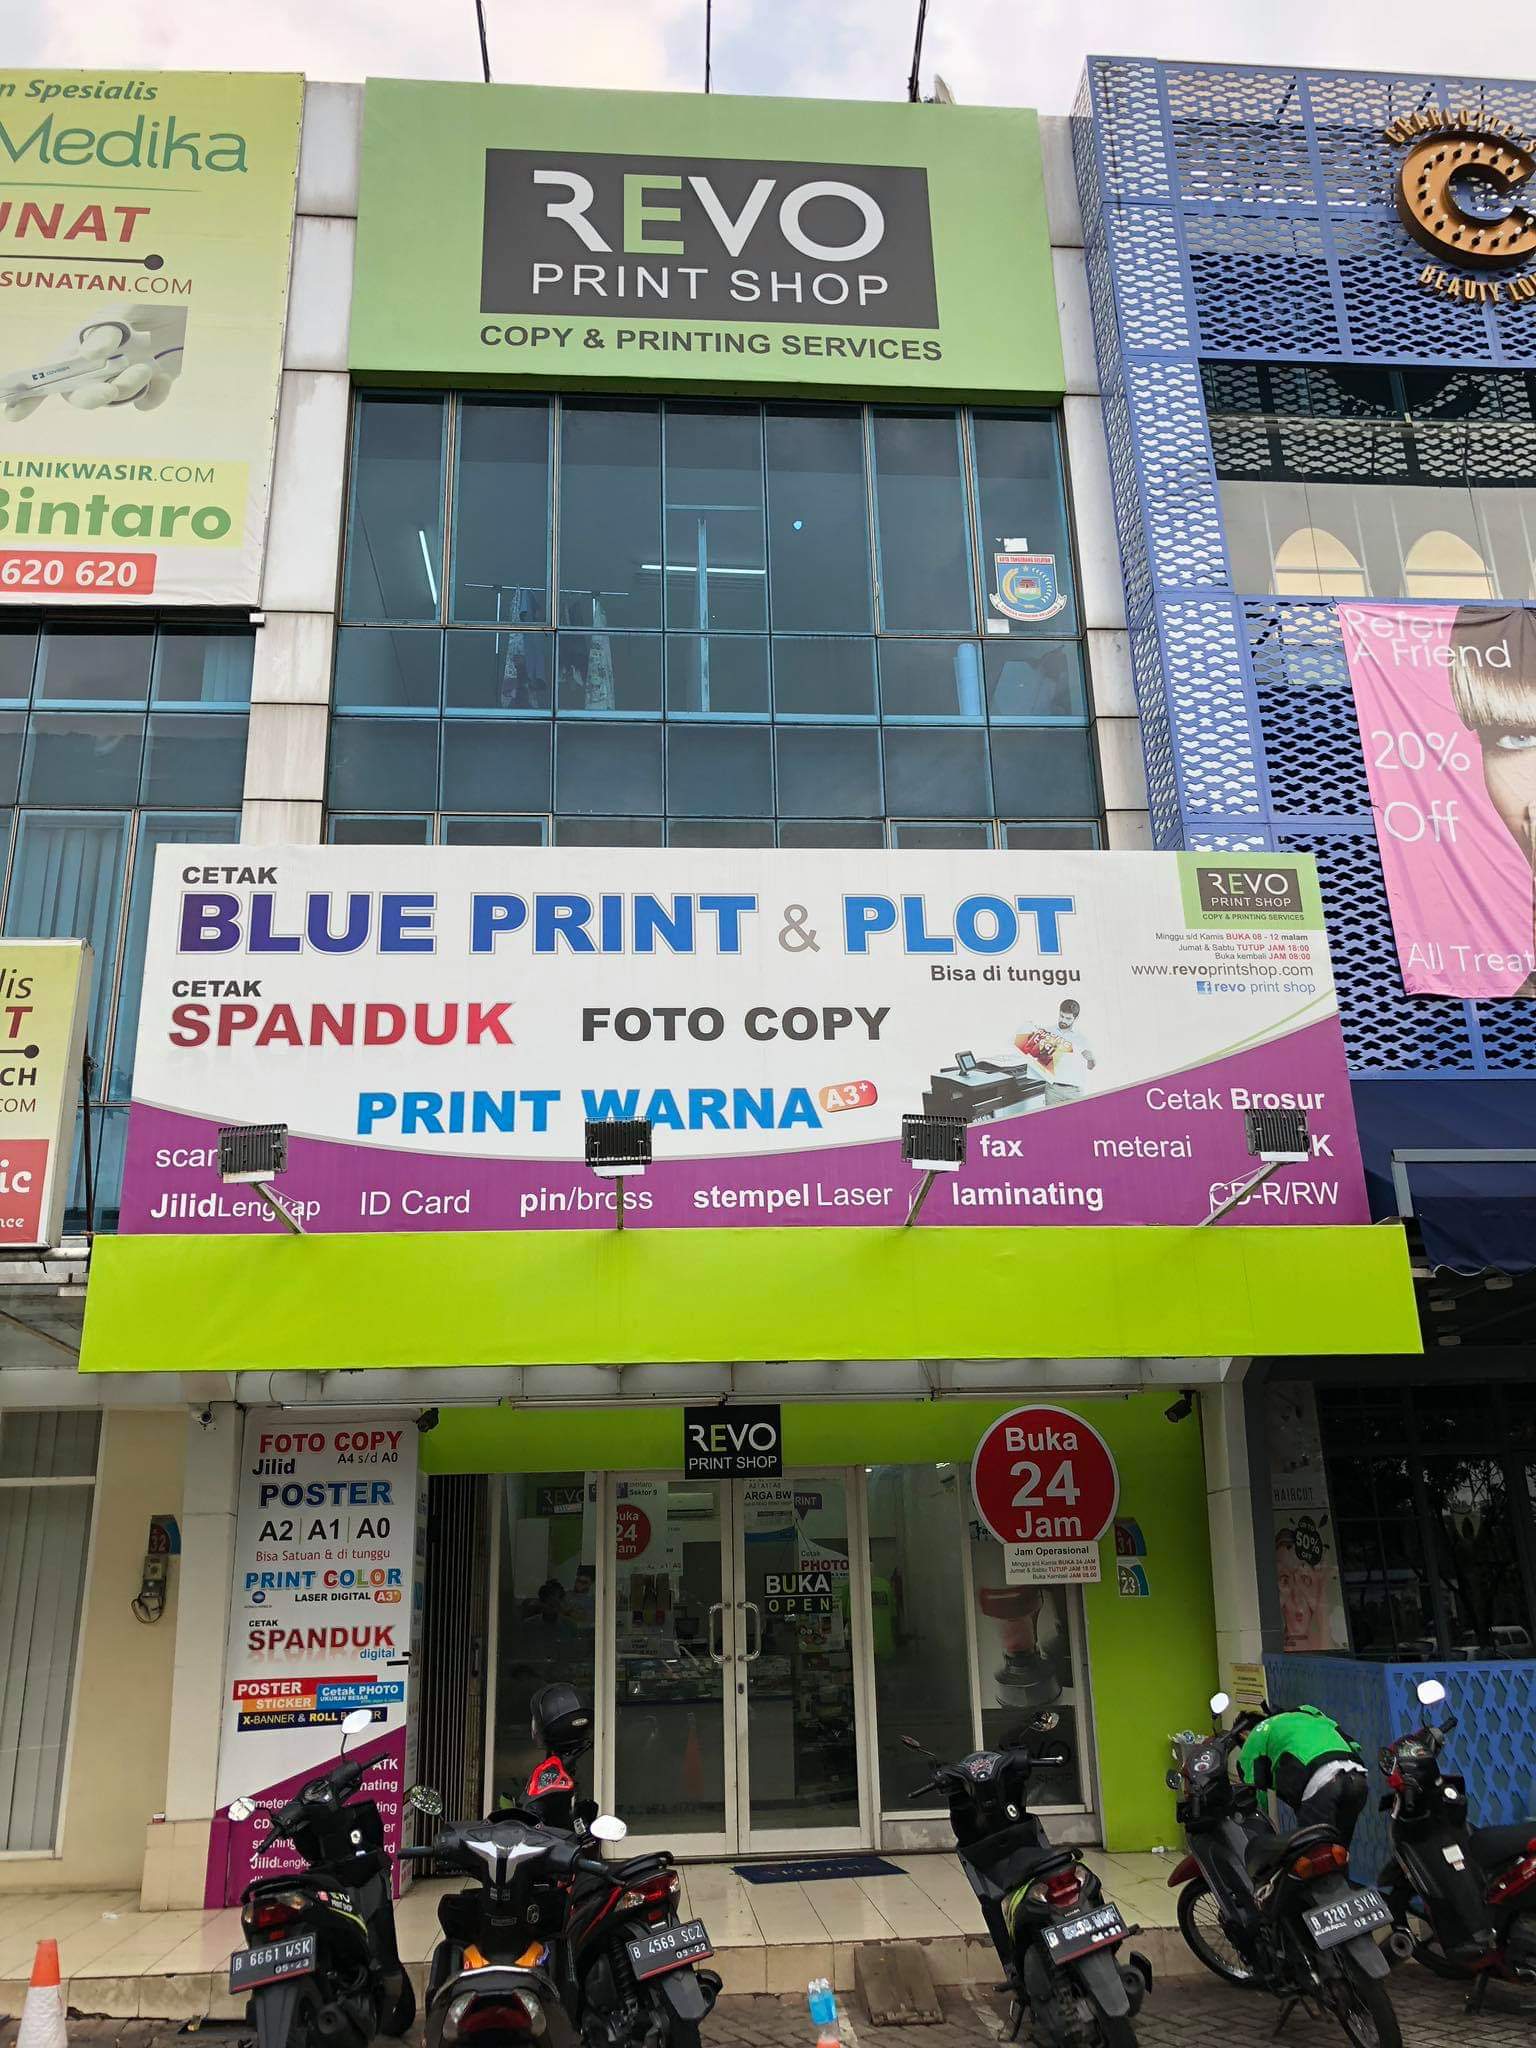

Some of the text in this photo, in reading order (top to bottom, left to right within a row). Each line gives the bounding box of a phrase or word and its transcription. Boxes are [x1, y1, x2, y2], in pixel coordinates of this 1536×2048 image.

[25, 79, 158, 104] Spesialis
[0, 112, 248, 173] Medika
[533, 169, 885, 262] REVO
[532, 263, 889, 306] PRINT SHOP
[1419, 265, 1500, 302] BEAUTY
[480, 325, 943, 361] COPY & PRINTING SERVICES
[0, 460, 215, 483] LINIKWASIR.COM
[0, 486, 232, 540] intaro
[1, 559, 138, 587] 620 620
[1344, 608, 1447, 639] Refer
[1352, 639, 1511, 669] A Friend
[1371, 730, 1471, 772] 20%
[1383, 800, 1459, 843] Off
[182, 866, 278, 884] CETAK
[1208, 873, 1288, 895] REVO
[1211, 897, 1291, 907] PRINT SHOP
[176, 890, 1077, 956] BLUE PRINT & PLOT
[1155, 933, 1184, 942] Minggu
[1200, 933, 1224, 941] Kamis
[1226, 933, 1251, 941] BUKA
[1252, 933, 1262, 941] 08
[1407, 942, 1443, 971] All
[930, 964, 1082, 986] Bisa di tunggu
[1131, 963, 1313, 978] www.revoprintshop.com
[172, 981, 261, 998] CETAK
[1215, 981, 1316, 995] revo print shop
[168, 1002, 891, 1048] SPANDUK FOTO COPY
[1146, 1088, 1325, 1111] Cetak Brosur
[357, 1090, 560, 1135] PRINT
[581, 1088, 822, 1130] WARNA
[980, 1134, 1193, 1158] fax meterai
[360, 1191, 391, 1216] ID
[402, 1189, 471, 1215] Card
[520, 1187, 653, 1218] pin/bross
[693, 1182, 811, 1211] stempel
[817, 1181, 893, 1207] Laser
[952, 1182, 1105, 1211] laminating
[259, 1431, 403, 1454] FOTO COPY
[689, 1422, 776, 1452] REVO
[1005, 1427, 1079, 1451] Buka
[252, 1458, 296, 1476] Jilid
[338, 1452, 398, 1464] A4 s/d A0
[689, 1455, 777, 1470] PRINT SHOP
[259, 1481, 393, 1508] POSTER
[1010, 1460, 1081, 1507] 24
[1273, 1488, 1313, 1502] HAIRCUT
[795, 1496, 816, 1505] RINT
[258, 1517, 390, 1541] A2 A1 A0
[1016, 1511, 1082, 1538] Jam
[1014, 1546, 1089, 1557] Jam Operasional
[1296, 1532, 1320, 1554] 50%
[256, 1549, 390, 1561] Bisa Satuan & di tunggu
[801, 1560, 849, 1571] PHOTO
[245, 1568, 402, 1590] PRINT COLOR
[765, 1574, 830, 1594] BUKA
[1121, 1576, 1136, 1593] 23
[295, 1592, 328, 1602] LASER
[331, 1592, 371, 1601] DIGITAL
[249, 1619, 278, 1627] CETAK
[248, 1625, 395, 1651] SPANDUK
[360, 1648, 395, 1660] digital
[237, 1682, 398, 1696] POSTER Cetak PHOTO
[256, 1697, 311, 1709] STICKER
[243, 1713, 294, 1724] X-BANNER
[298, 1713, 305, 1722] &
[310, 1712, 337, 1721] ROLL
[633, 1925, 703, 1959] B 4569 SCZ
[236, 1939, 311, 1972] B 6661 WSK
